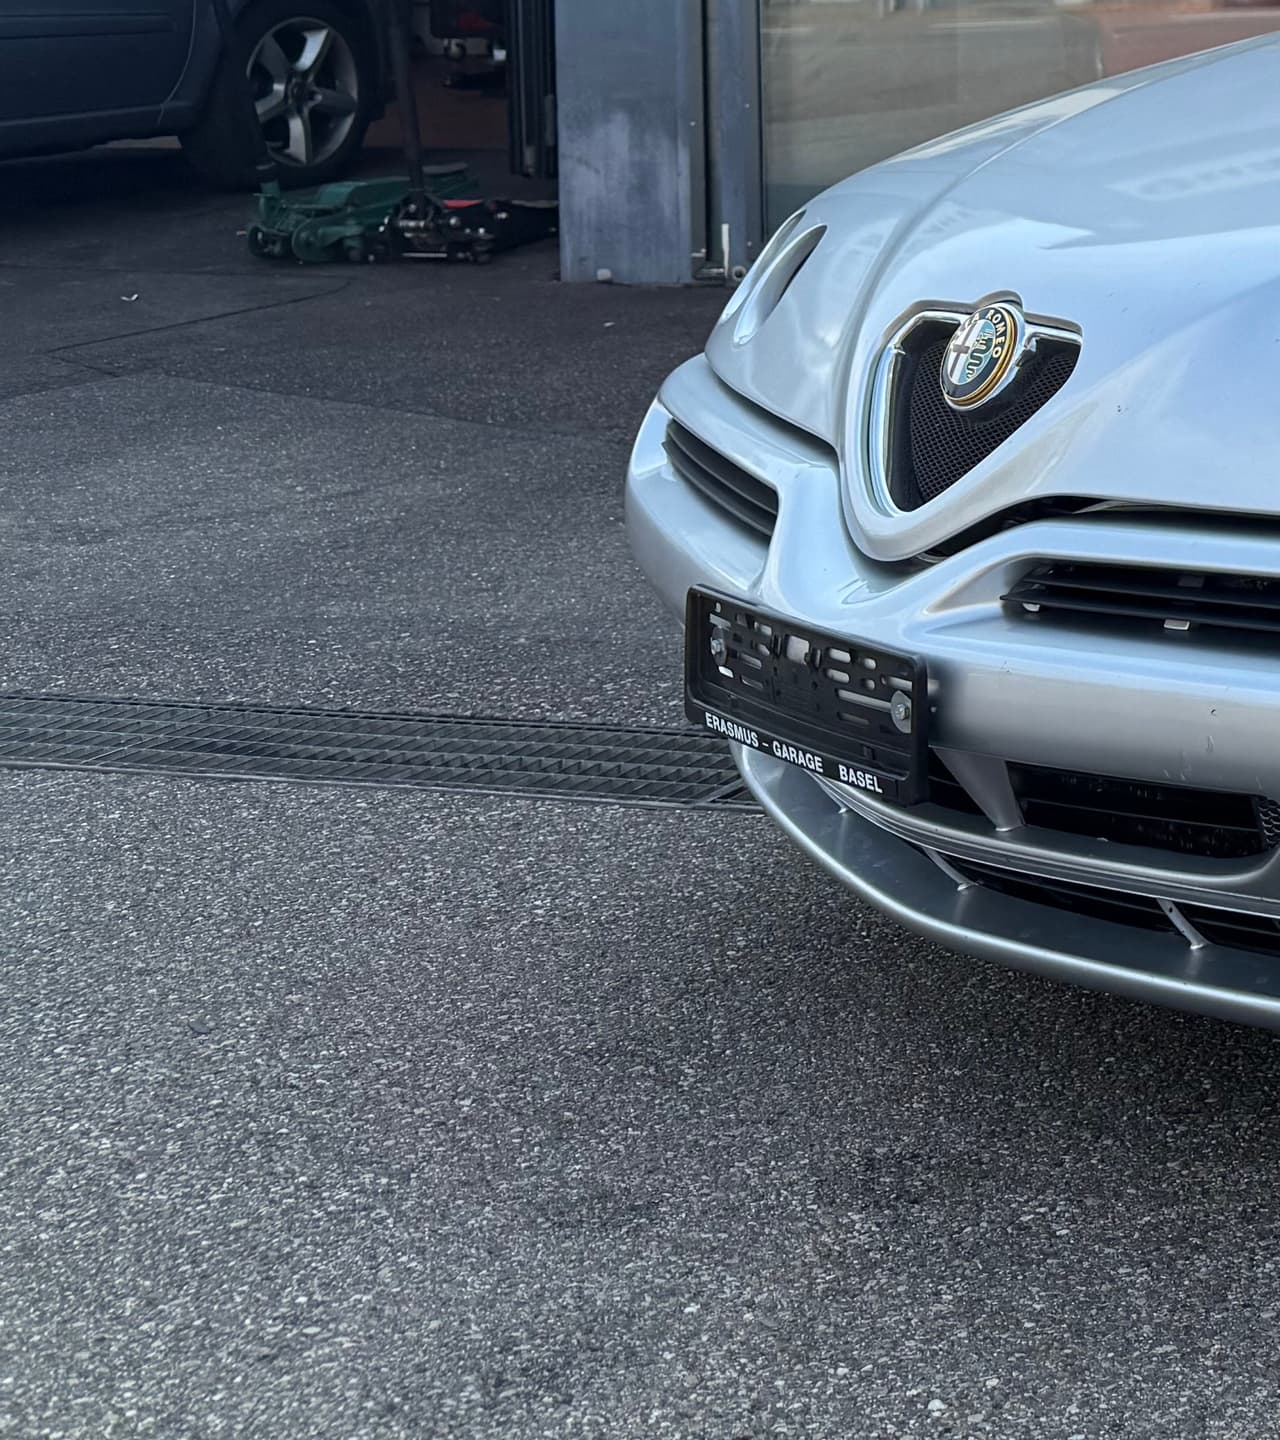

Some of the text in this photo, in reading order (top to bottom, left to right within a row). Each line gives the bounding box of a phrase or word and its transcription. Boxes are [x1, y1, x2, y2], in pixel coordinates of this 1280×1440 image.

[985, 309, 1007, 358] ROMEO
[704, 712, 759, 748] ERASMUS
[772, 740, 824, 774] GARAGE
[838, 764, 883, 794] BASEL
